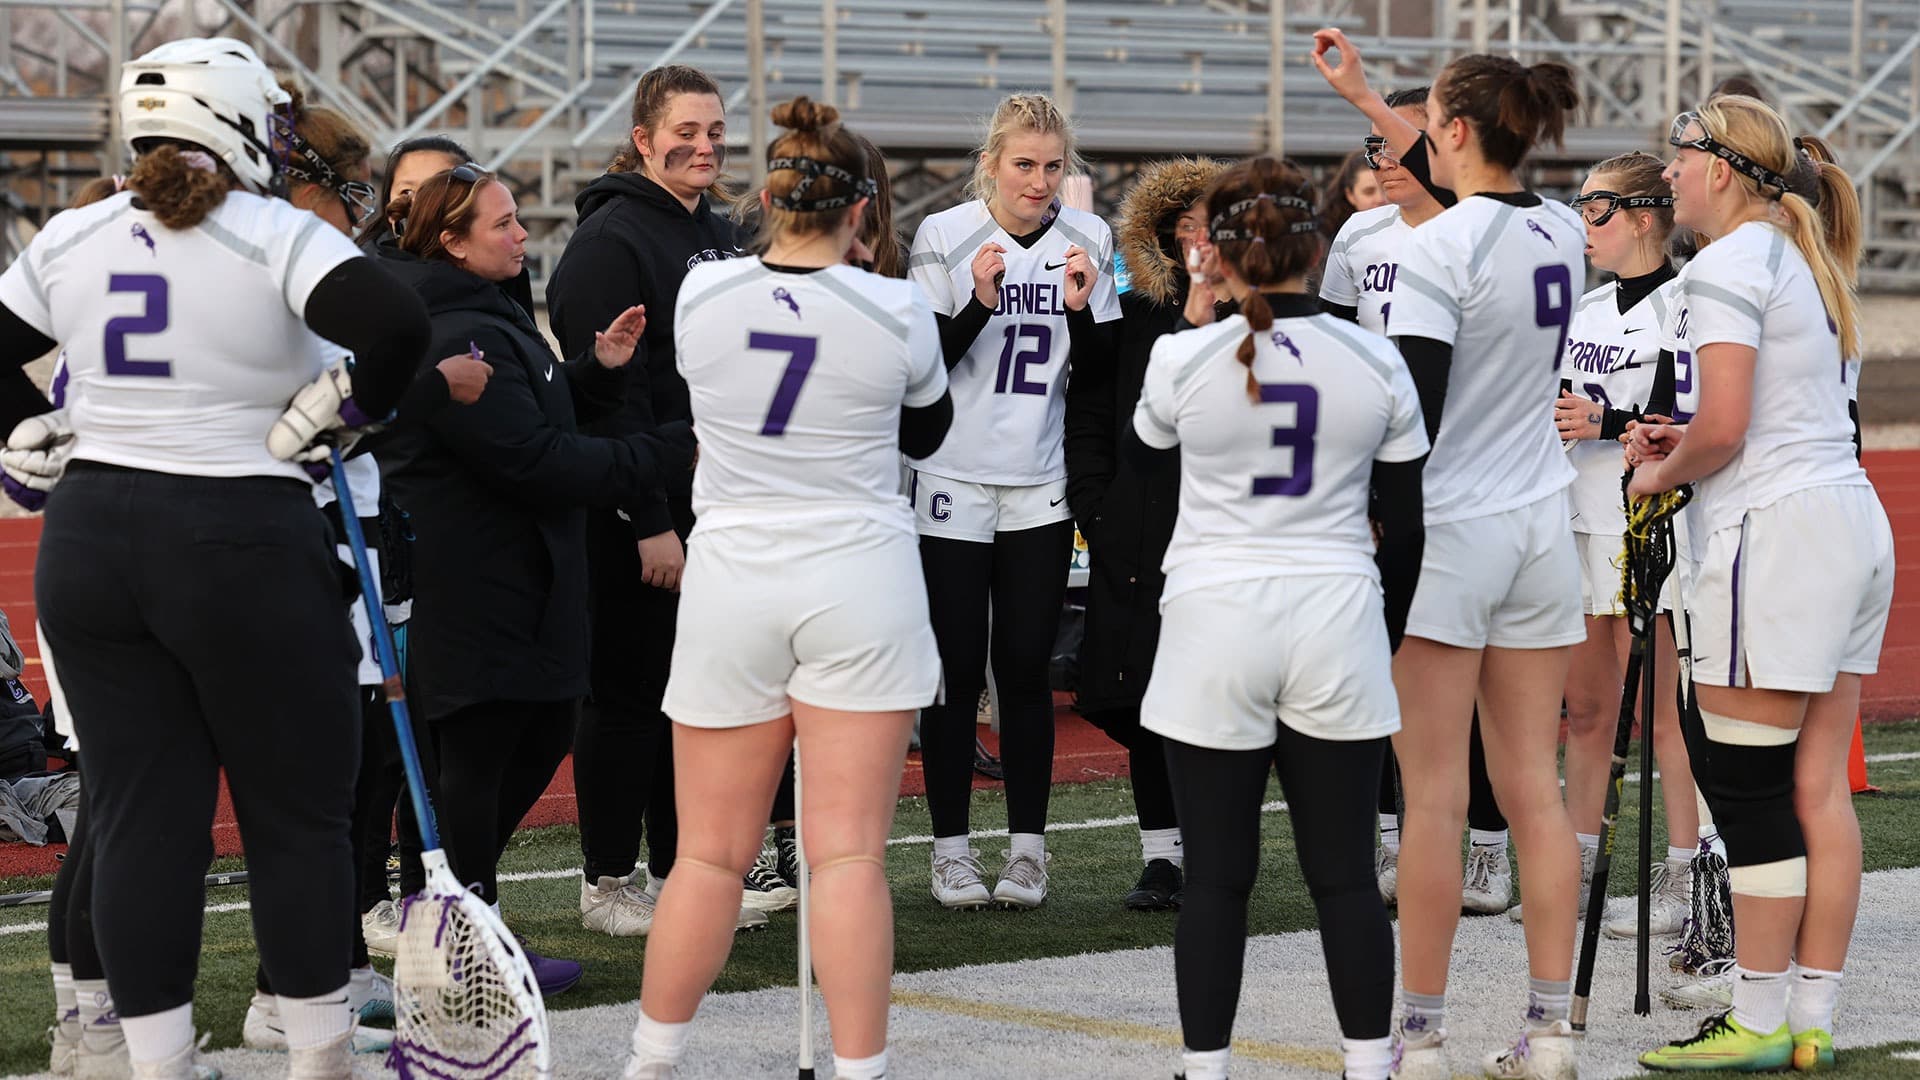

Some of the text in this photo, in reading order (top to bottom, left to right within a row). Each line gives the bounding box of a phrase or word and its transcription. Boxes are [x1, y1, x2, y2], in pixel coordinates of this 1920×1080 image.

[1718, 147, 1746, 168] STX
[1630, 197, 1657, 207] STX
[1662, 197, 1675, 207] ST
[103, 273, 171, 377] 2
[972, 283, 1065, 316] ORNEL
[1534, 264, 1572, 372] 9
[748, 330, 818, 436] 7
[994, 323, 1052, 395] 12
[1251, 383, 1319, 496] 3
[929, 491, 953, 523] C
